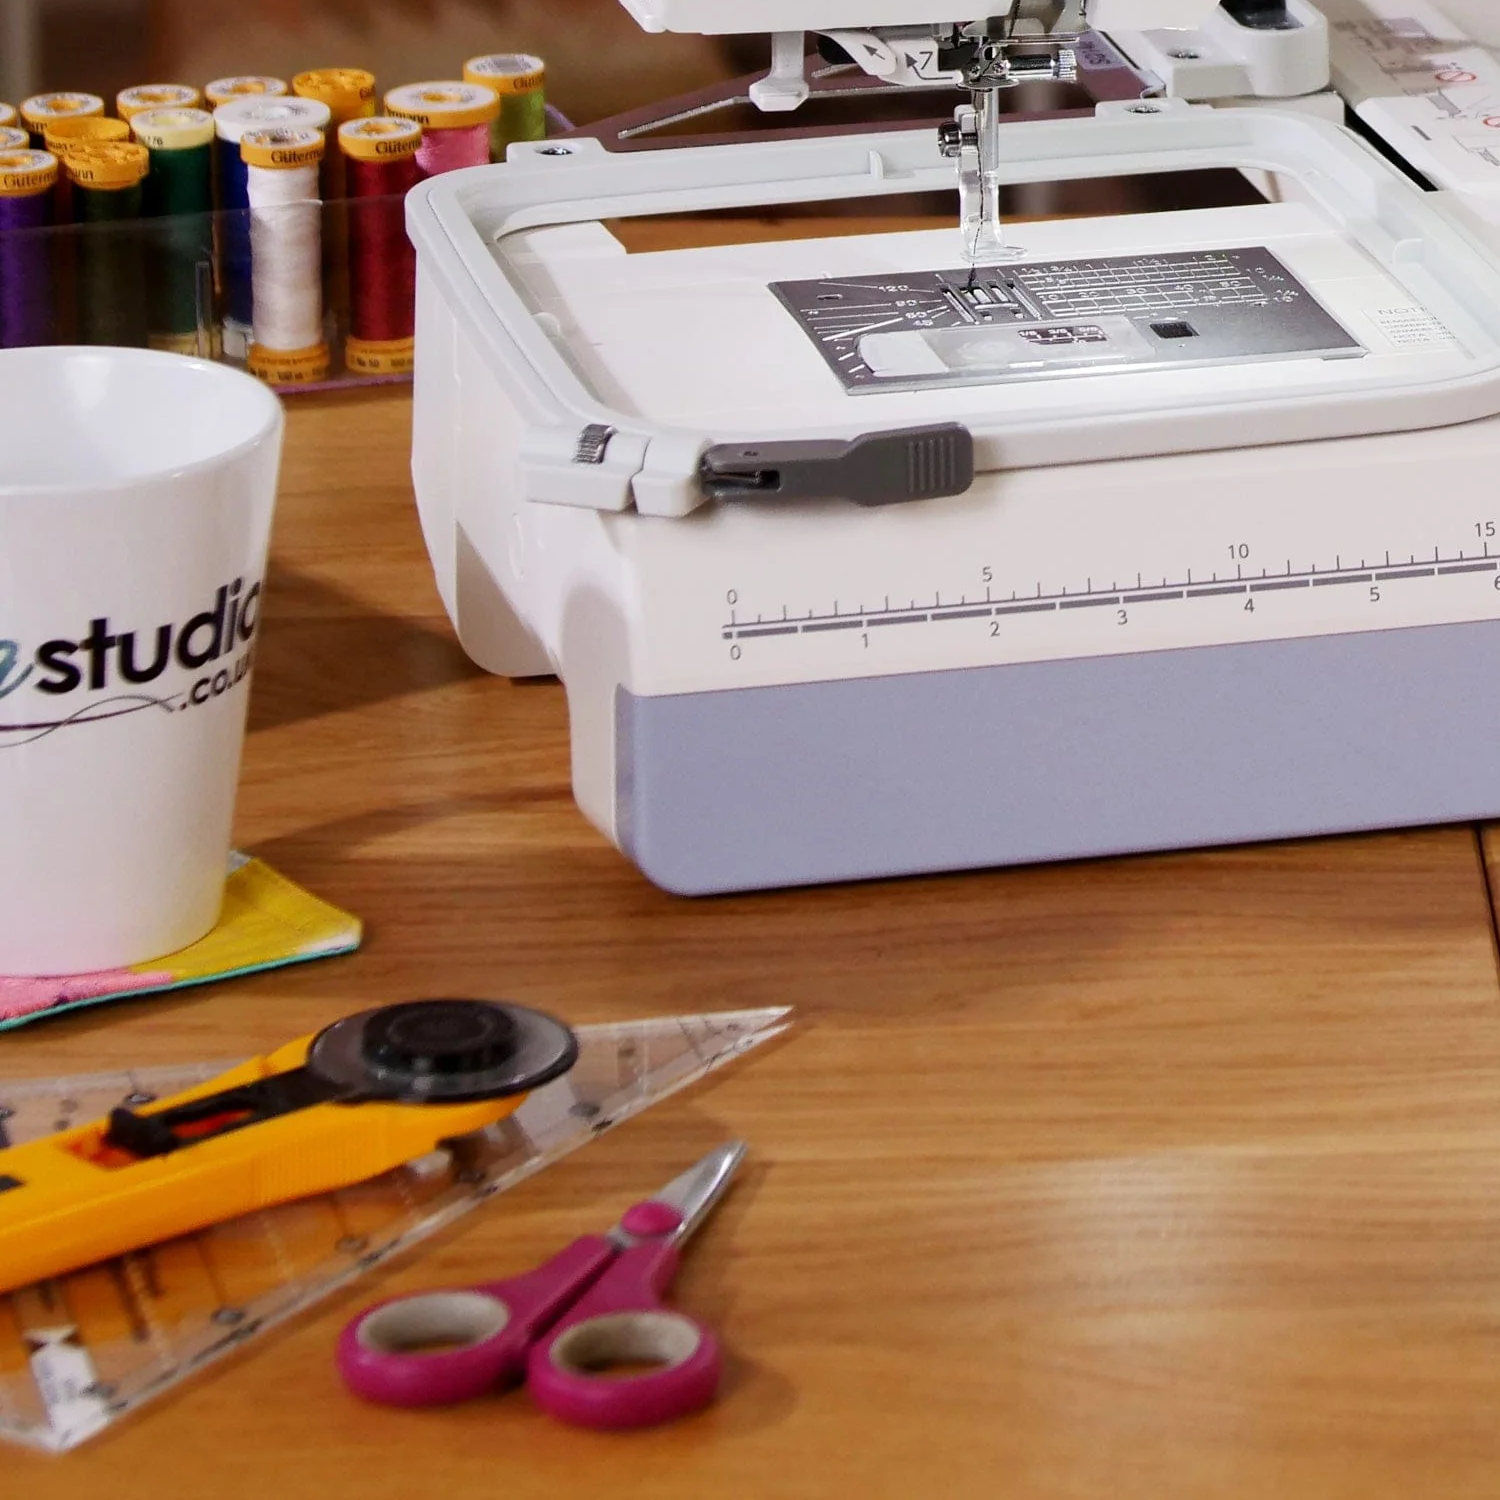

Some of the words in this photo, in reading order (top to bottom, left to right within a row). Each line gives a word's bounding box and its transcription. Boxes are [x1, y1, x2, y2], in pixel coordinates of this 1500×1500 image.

[919, 51, 934, 70] 7
[726, 589, 739, 605] 0
[981, 566, 993, 583] 5
[1228, 543, 1250, 560] 10
[1474, 521, 1496, 537] 15
[730, 645, 742, 661] 0
[861, 633, 869, 649] 1
[989, 621, 1001, 638] 2
[1117, 610, 1129, 626] 3
[1243, 598, 1256, 614] 4
[1369, 587, 1381, 603] 5
